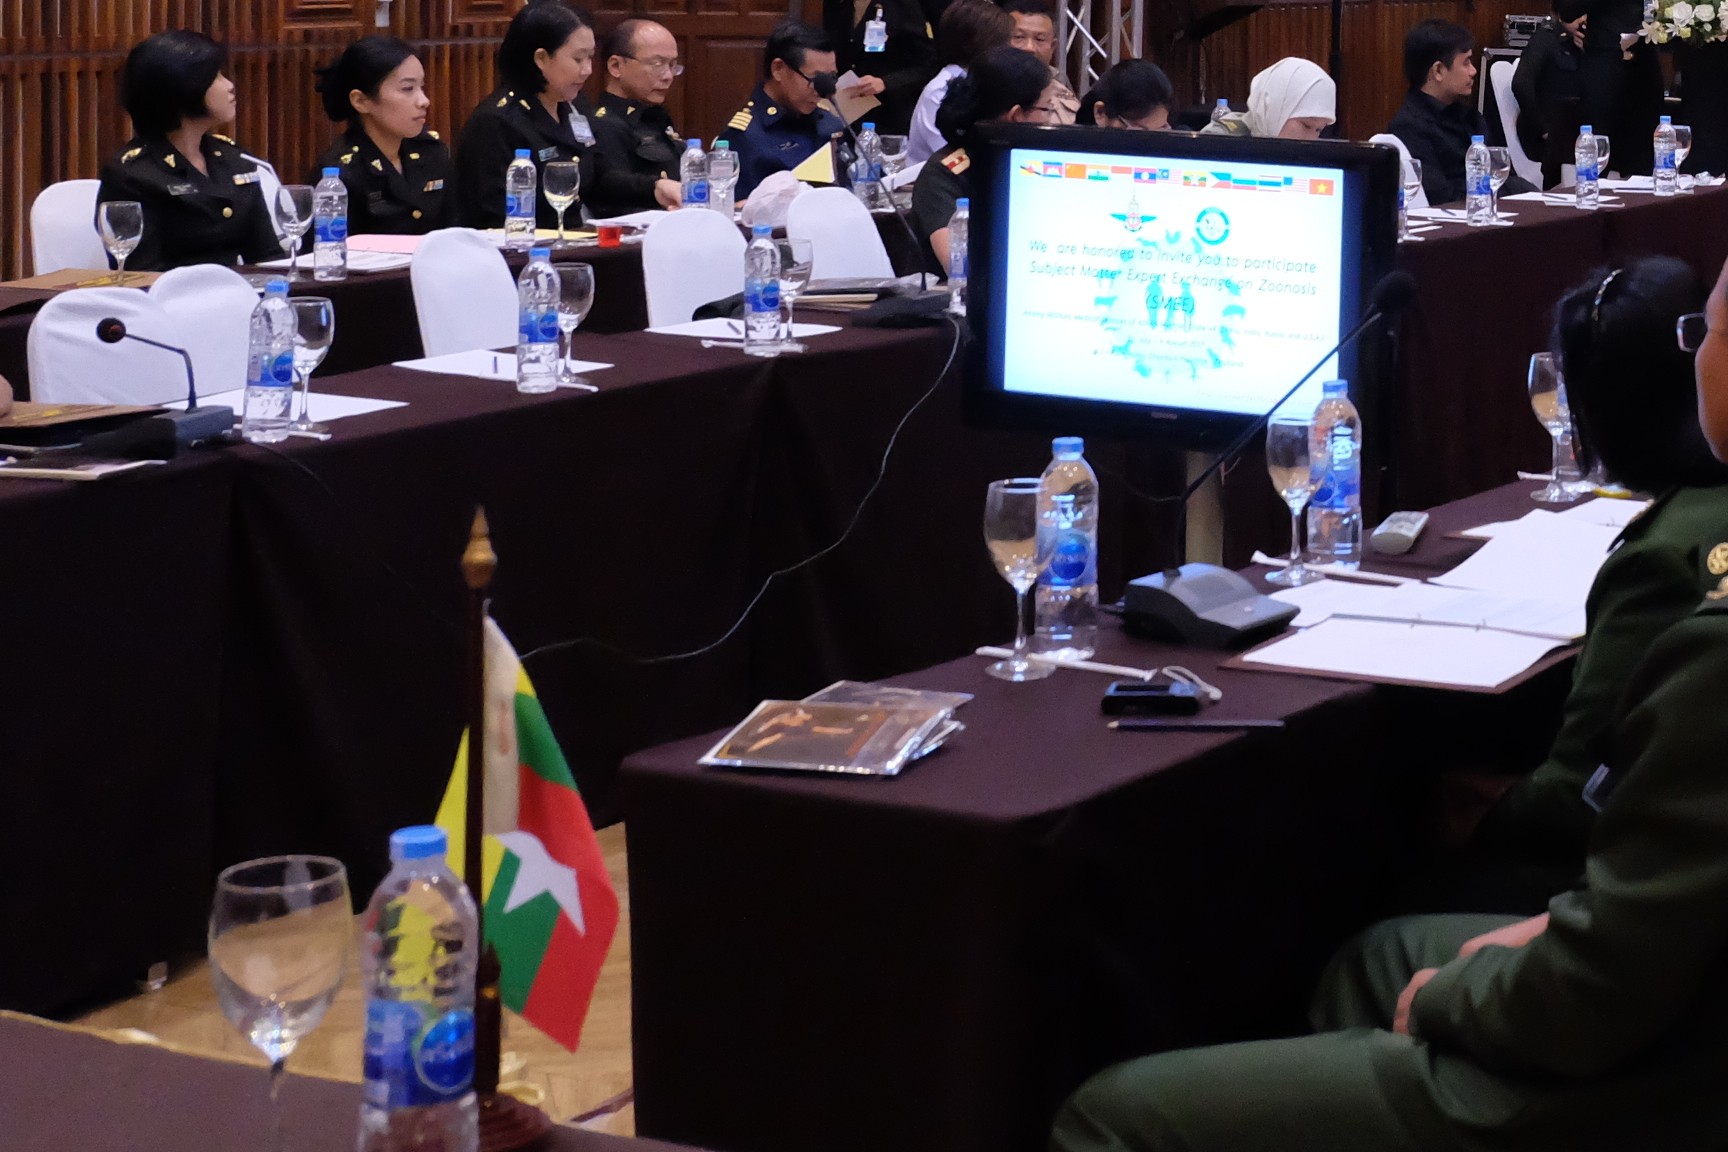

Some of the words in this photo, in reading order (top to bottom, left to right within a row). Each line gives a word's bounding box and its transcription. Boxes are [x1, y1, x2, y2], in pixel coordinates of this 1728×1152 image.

[1029, 239, 1048, 253] We
[1056, 243, 1077, 255] are
[1081, 242, 1135, 260] honored
[1139, 249, 1153, 261] to
[1157, 248, 1193, 264] invite
[1199, 253, 1222, 267] you
[1226, 254, 1239, 267] to
[1243, 256, 1318, 274] participate
[1029, 260, 1076, 278] Subject
[1127, 268, 1167, 284] Expert
[1171, 271, 1233, 291] Exchange
[1258, 278, 1317, 296] Zoonosis
